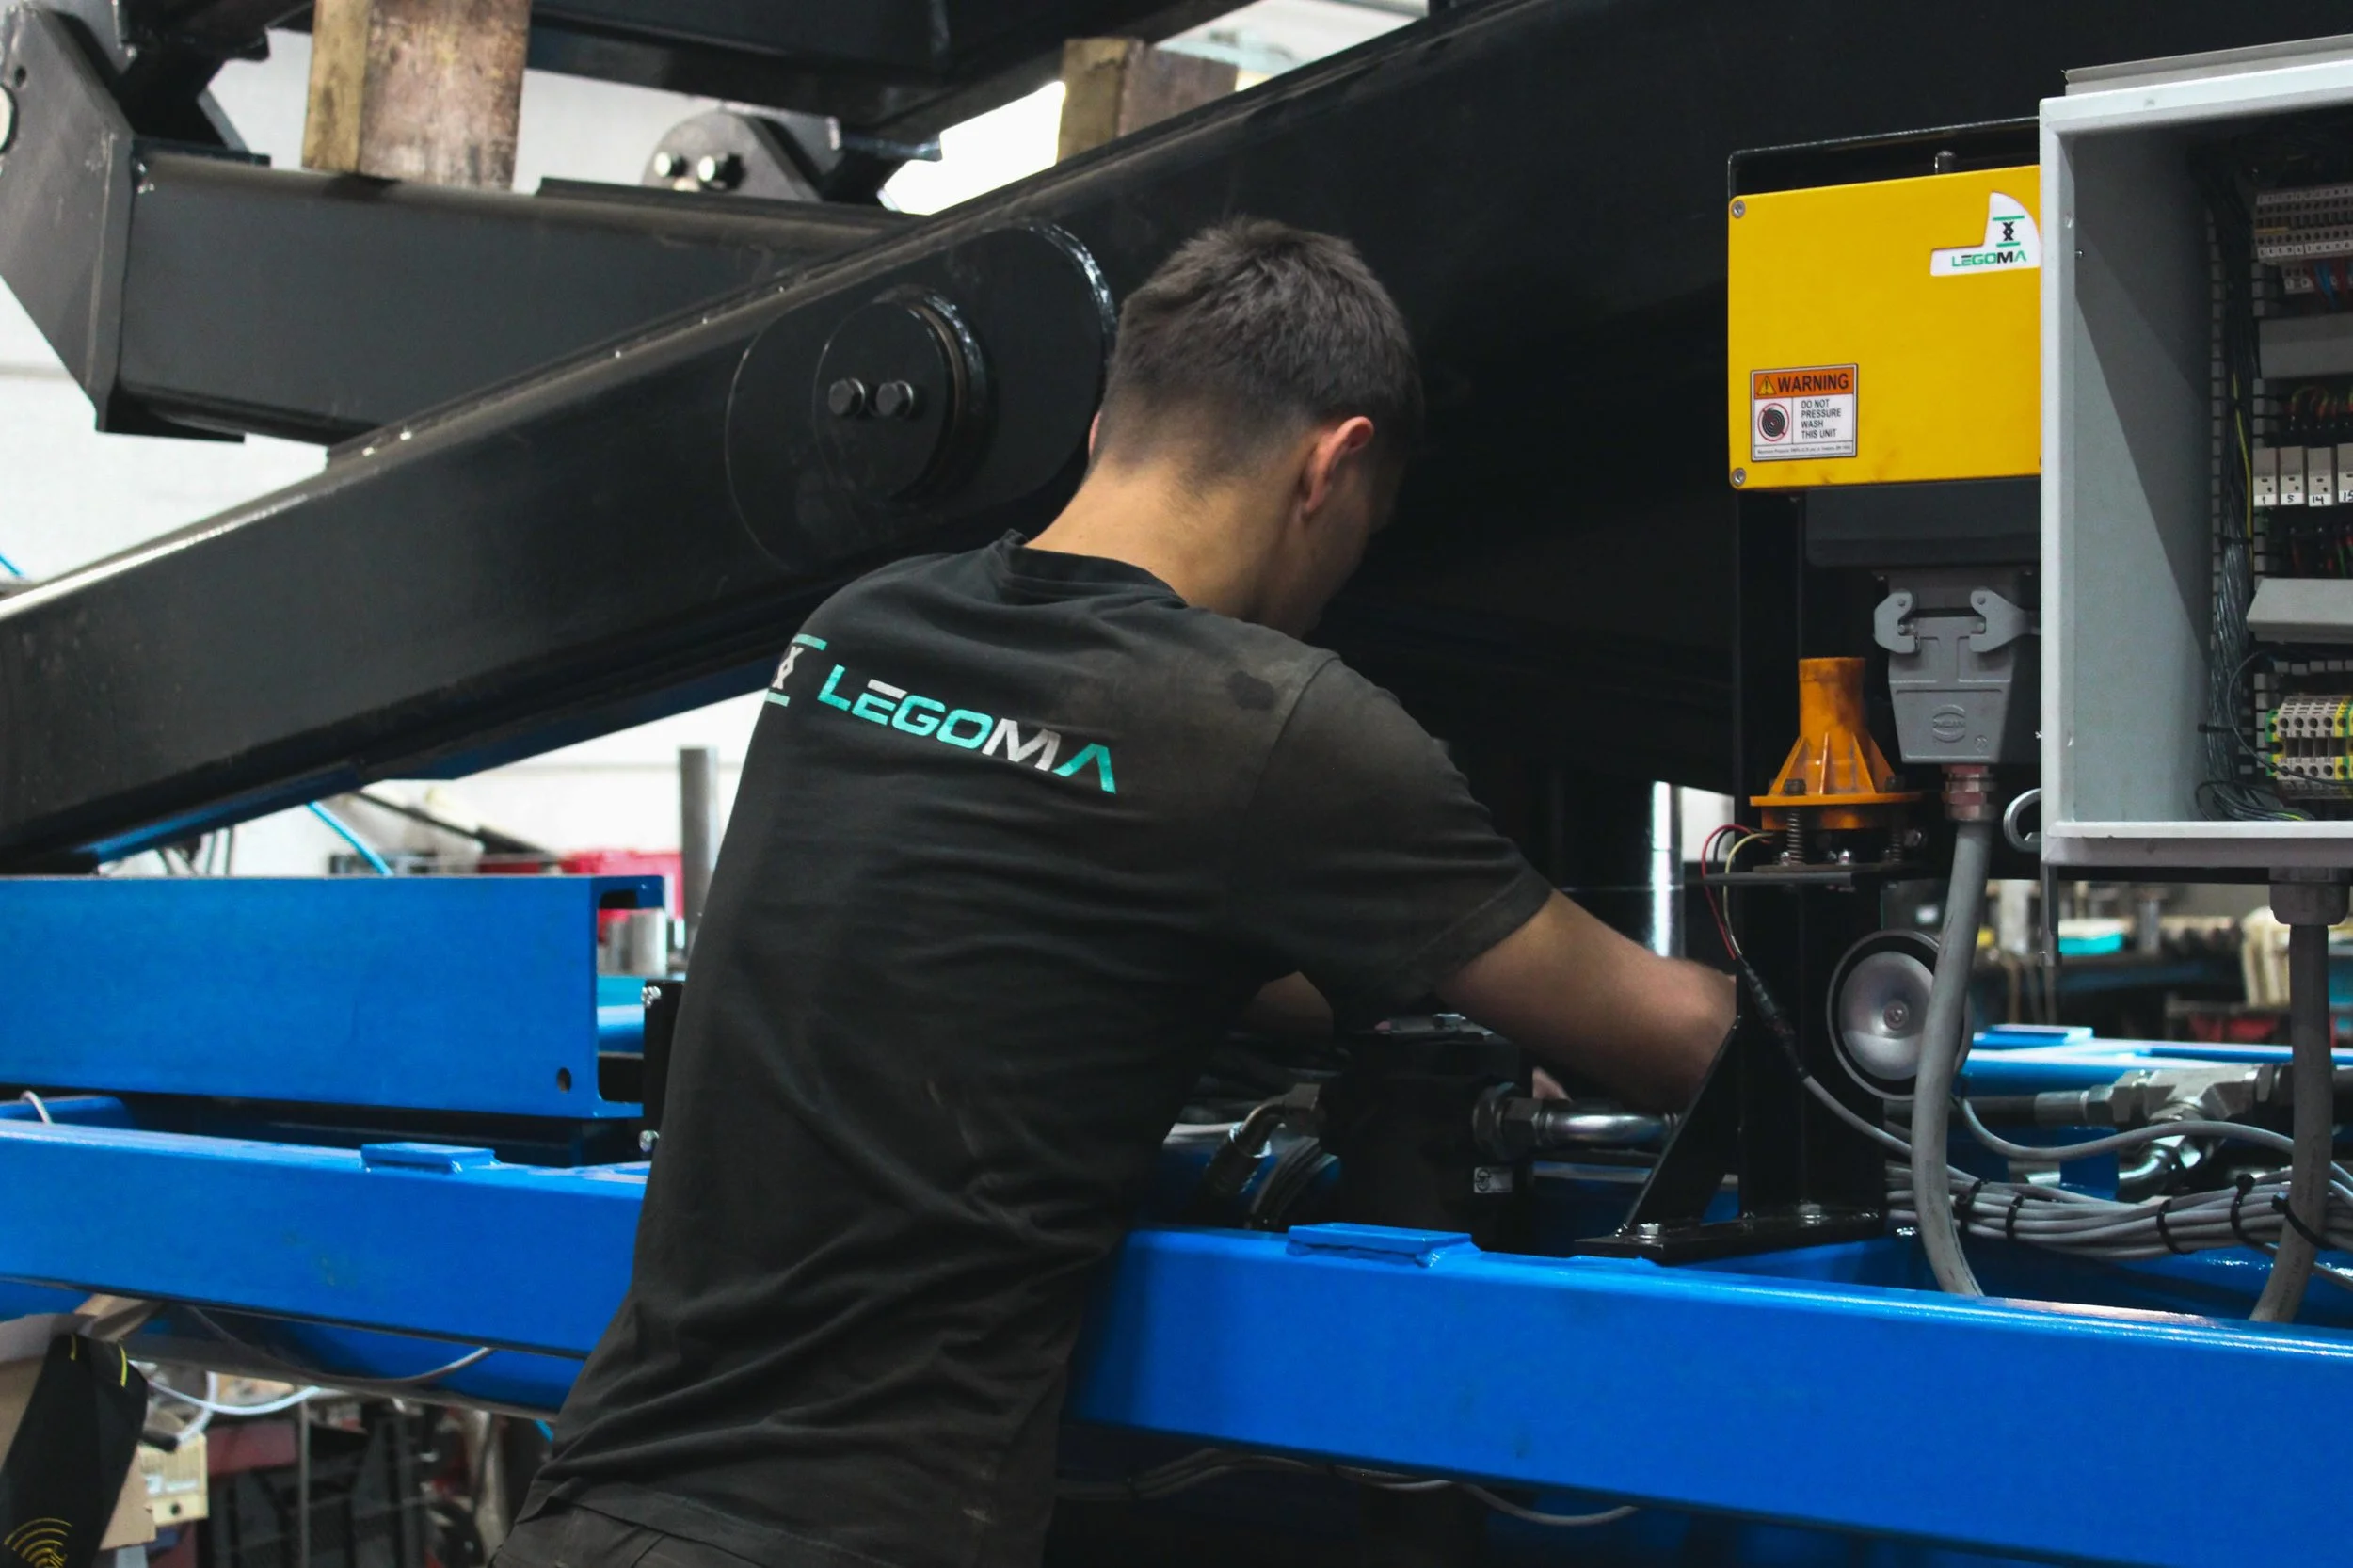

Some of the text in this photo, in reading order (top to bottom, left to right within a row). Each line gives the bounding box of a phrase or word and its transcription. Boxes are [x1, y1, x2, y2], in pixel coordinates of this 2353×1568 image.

[1951, 250, 2027, 267] LEGOMA
[1777, 373, 1849, 392] WARNING
[1801, 398, 1830, 408] DO NOT
[1801, 408, 1841, 418] PRESSURE
[1801, 420, 1824, 428] WASH
[1801, 428, 1837, 440] THIS UNIT
[2312, 496, 2324, 504] 14
[817, 664, 1117, 794] LEGOMA
